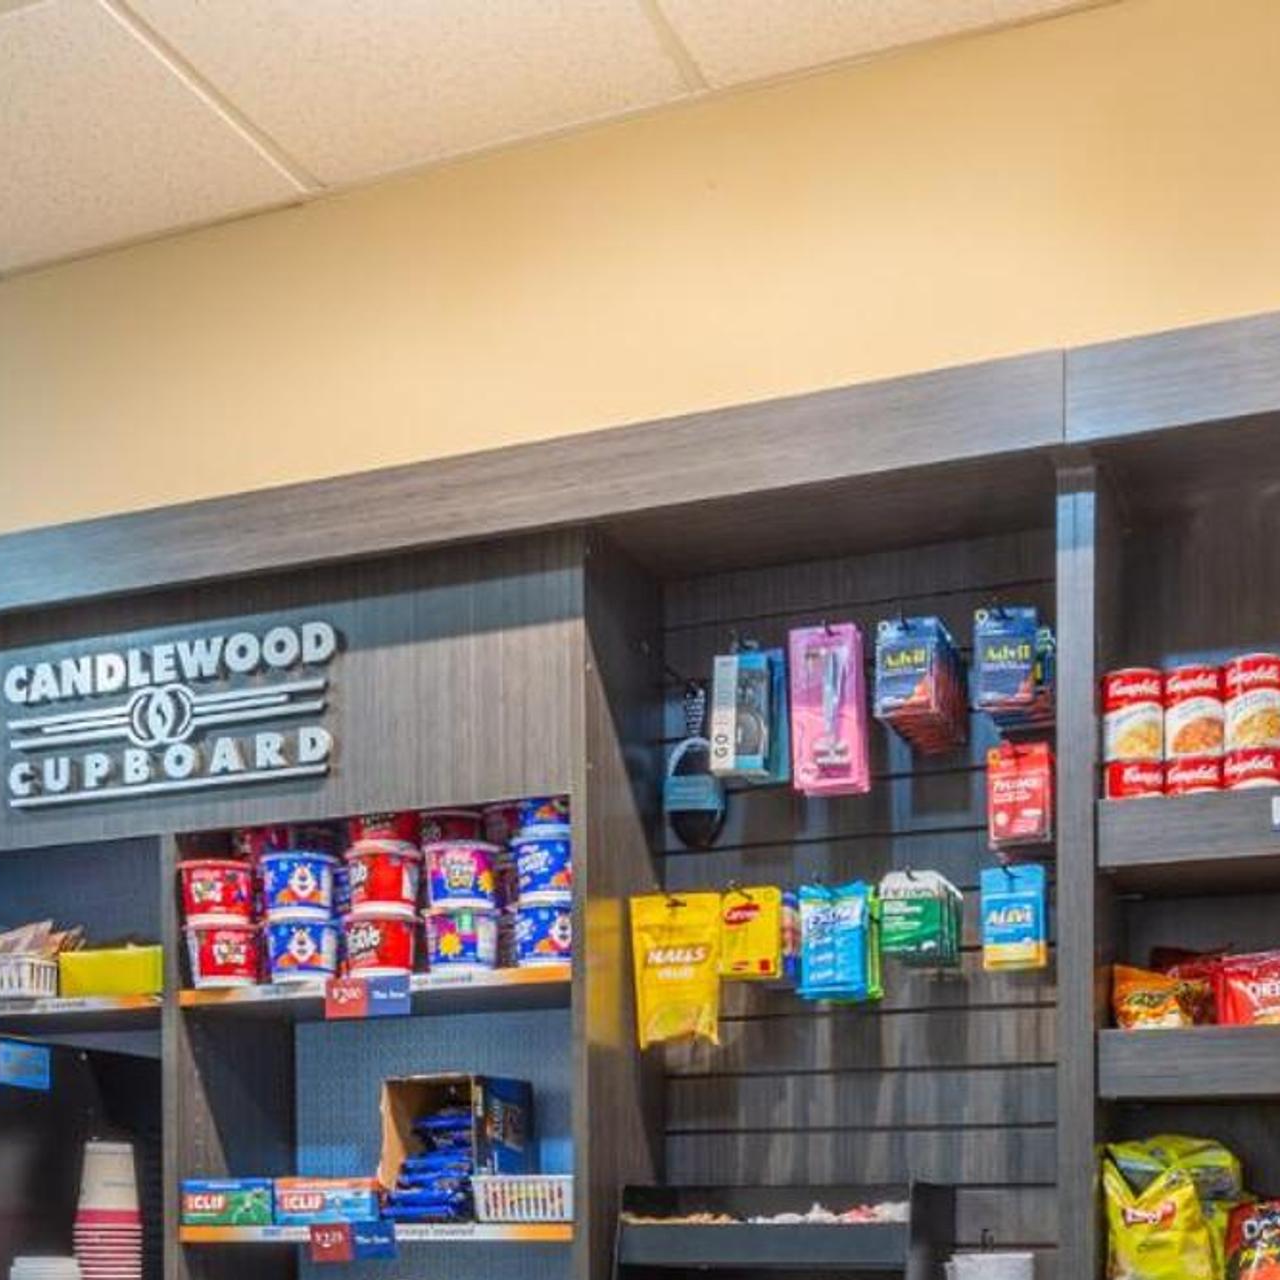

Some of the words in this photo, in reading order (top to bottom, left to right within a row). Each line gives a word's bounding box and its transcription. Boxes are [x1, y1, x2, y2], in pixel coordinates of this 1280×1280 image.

[4, 621, 337, 703] CANDLEWOOD
[884, 648, 927, 669] Advil
[984, 644, 1031, 663] Advil
[7, 726, 335, 796] CUPBOARD
